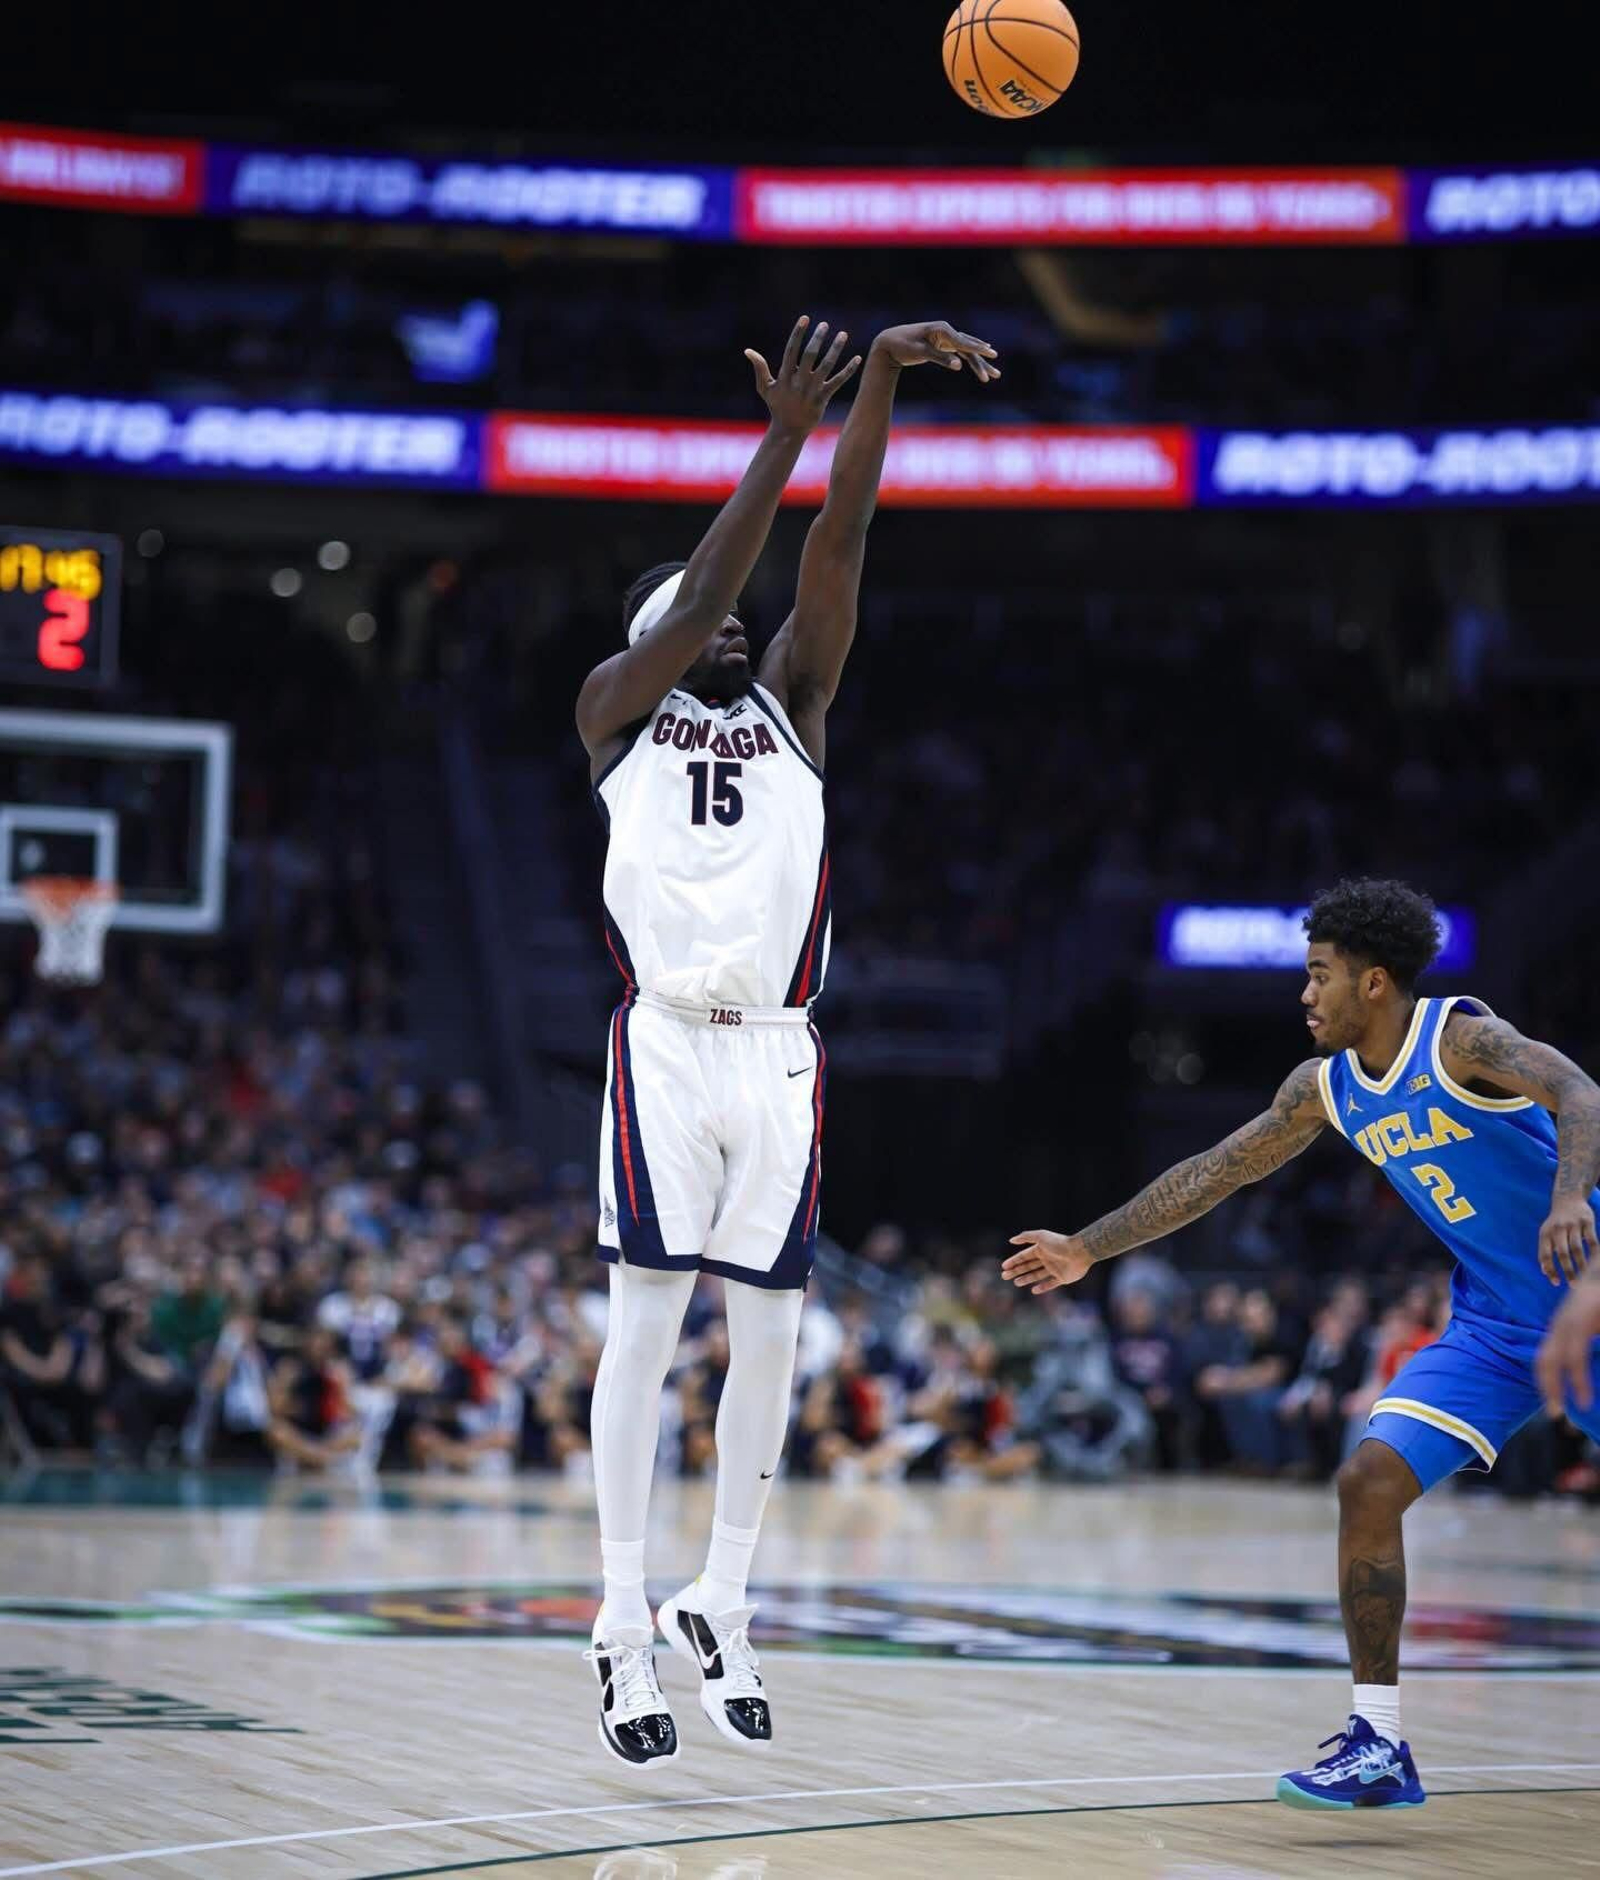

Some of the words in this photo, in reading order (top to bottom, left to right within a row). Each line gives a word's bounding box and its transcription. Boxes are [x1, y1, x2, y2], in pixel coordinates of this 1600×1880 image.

[38, 588, 89, 671] 2
[652, 712, 779, 760] GONAGA
[686, 761, 744, 827] 15
[709, 1008, 743, 1026] ZAGS
[1354, 1107, 1475, 1166] UCLA
[1410, 1163, 1477, 1223] 2
